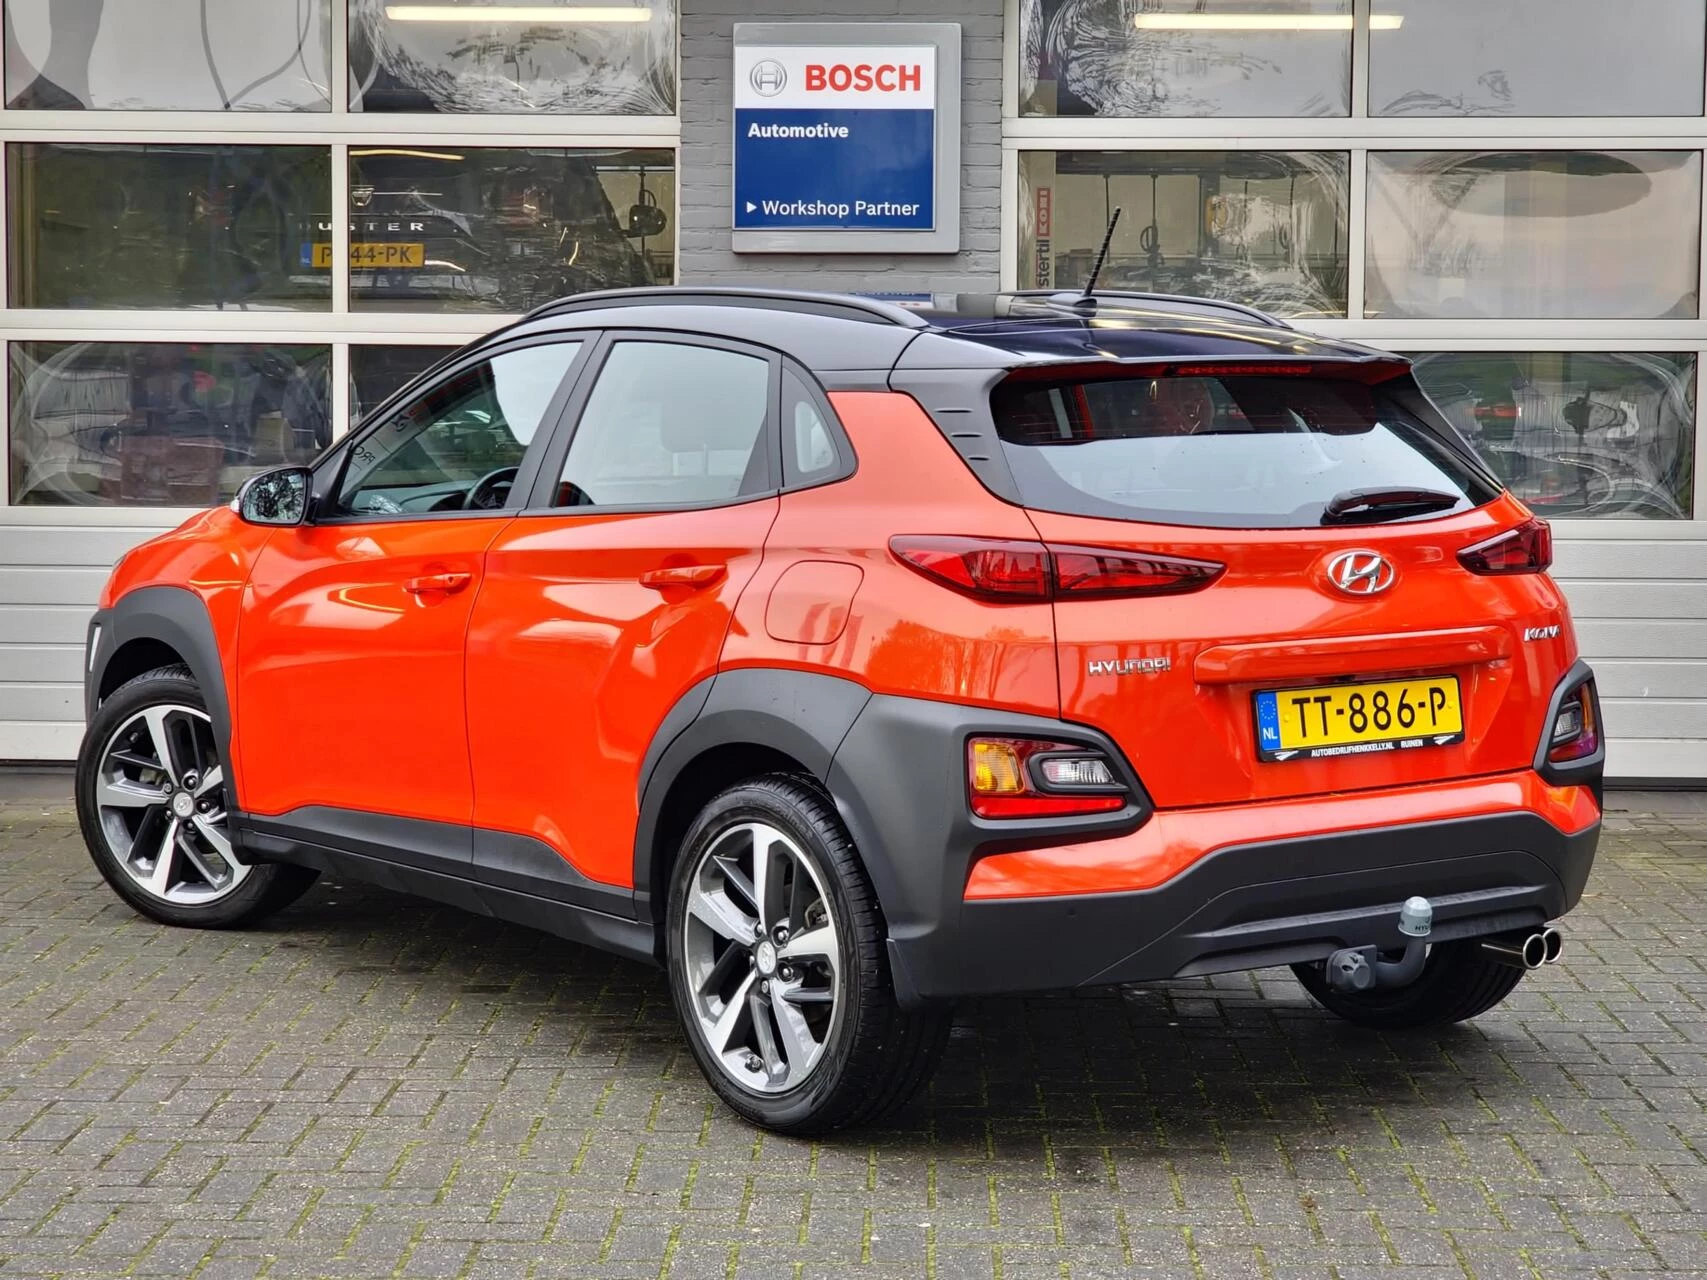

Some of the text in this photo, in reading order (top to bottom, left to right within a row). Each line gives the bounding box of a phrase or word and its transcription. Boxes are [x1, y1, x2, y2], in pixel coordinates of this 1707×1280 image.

[805, 64, 921, 92] BOSCH
[748, 122, 849, 138] Automotive
[762, 200, 920, 218] Workshop Partner
[1036, 189, 1050, 288] stertil KONI
[1087, 656, 1171, 676] HYUNDAI
[1263, 687, 1446, 740] NL TT-886-P
[1400, 739, 1424, 749] RUINEN
